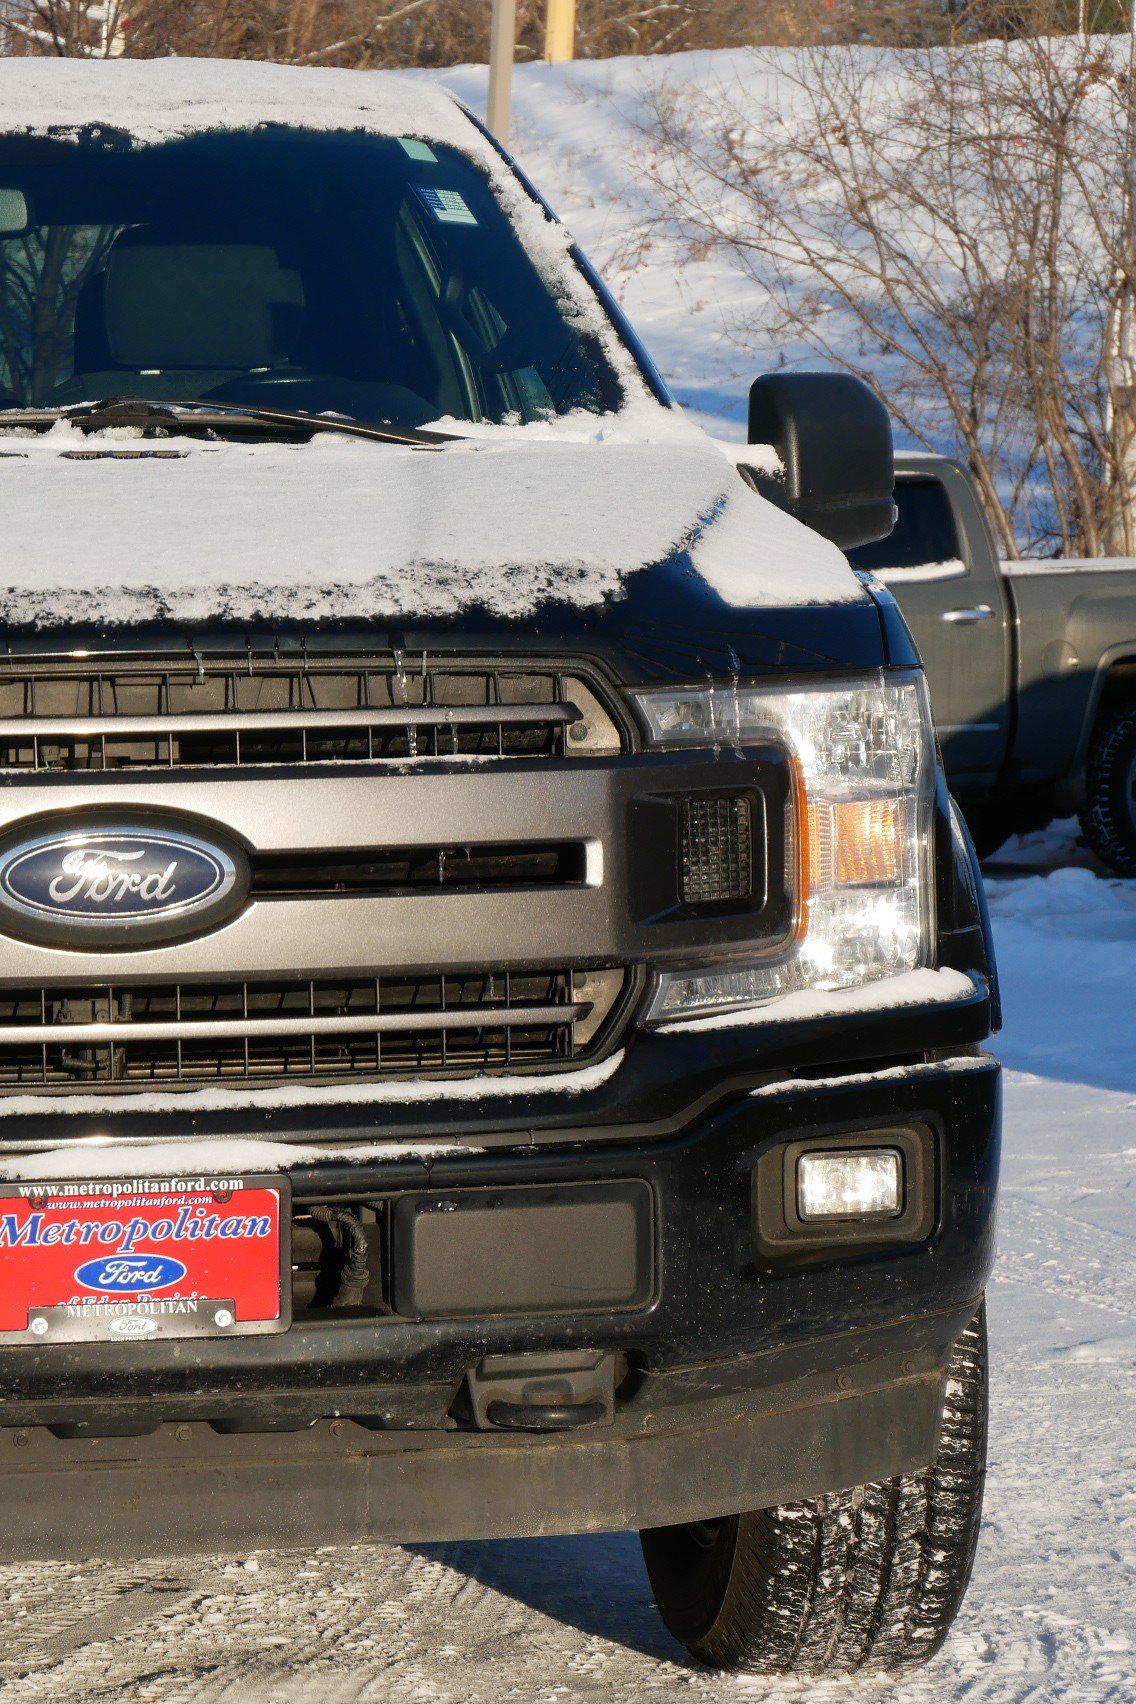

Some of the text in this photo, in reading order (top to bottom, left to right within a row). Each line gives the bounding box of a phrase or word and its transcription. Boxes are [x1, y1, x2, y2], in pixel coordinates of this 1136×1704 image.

[49, 849, 178, 903] Ford
[18, 1178, 244, 1198] www.metropolitanford.com
[47, 1195, 213, 1210] www.metropolitanford.com
[98, 1260, 162, 1287] Ford
[66, 1300, 198, 1318] METROPOLITAN
[118, 1318, 146, 1331] Ford
